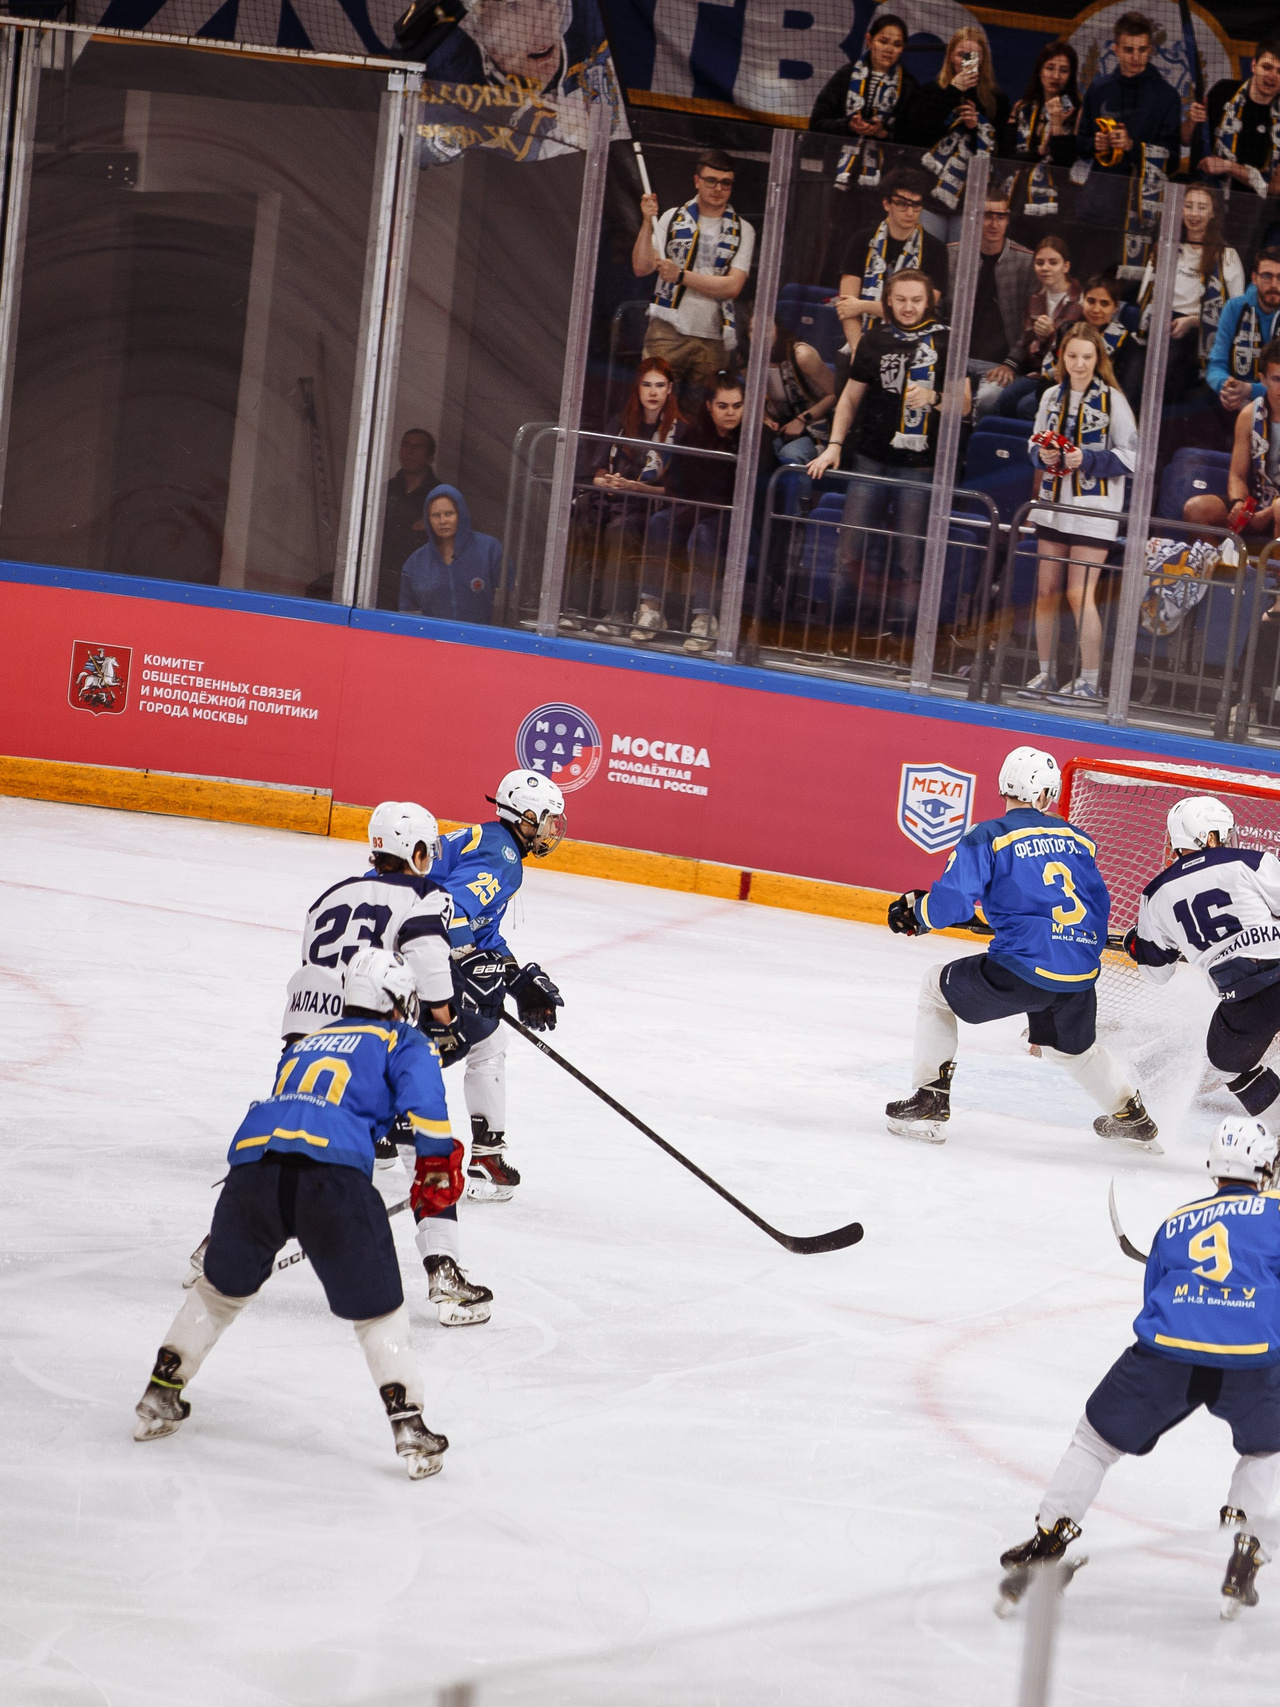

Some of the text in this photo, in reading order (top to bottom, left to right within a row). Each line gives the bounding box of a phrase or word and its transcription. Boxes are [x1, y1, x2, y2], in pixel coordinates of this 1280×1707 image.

[144, 653, 204, 672] КОМИТЕТ
[142, 669, 302, 702] ОБЩЕСТВЕННЫХ СВЯЗЕЙ
[139, 700, 248, 726] ГОРОДА МОСКВЫ
[141, 685, 319, 720] И МОЛОДЁЖНОЙ ПОЛИТИКИ
[610, 734, 711, 768] МОСКВА
[607, 772, 661, 789] СТОЛИЦА
[663, 780, 708, 797] РОССИИ
[608, 758, 691, 781] МОЛОДЁЖНАЯ
[911, 776, 963, 798] МСХЛ
[373, 837, 383, 848] 93
[465, 872, 502, 906] 25
[1042, 861, 1087, 926] 3
[309, 902, 393, 969] 23
[1173, 888, 1243, 952] 16
[271, 1056, 352, 1107] 10
[1226, 1133, 1234, 1146] 9
[1166, 1197, 1266, 1239] СТУПАКОВ
[278, 1250, 306, 1270] CC
[1188, 1221, 1233, 1283] 9
